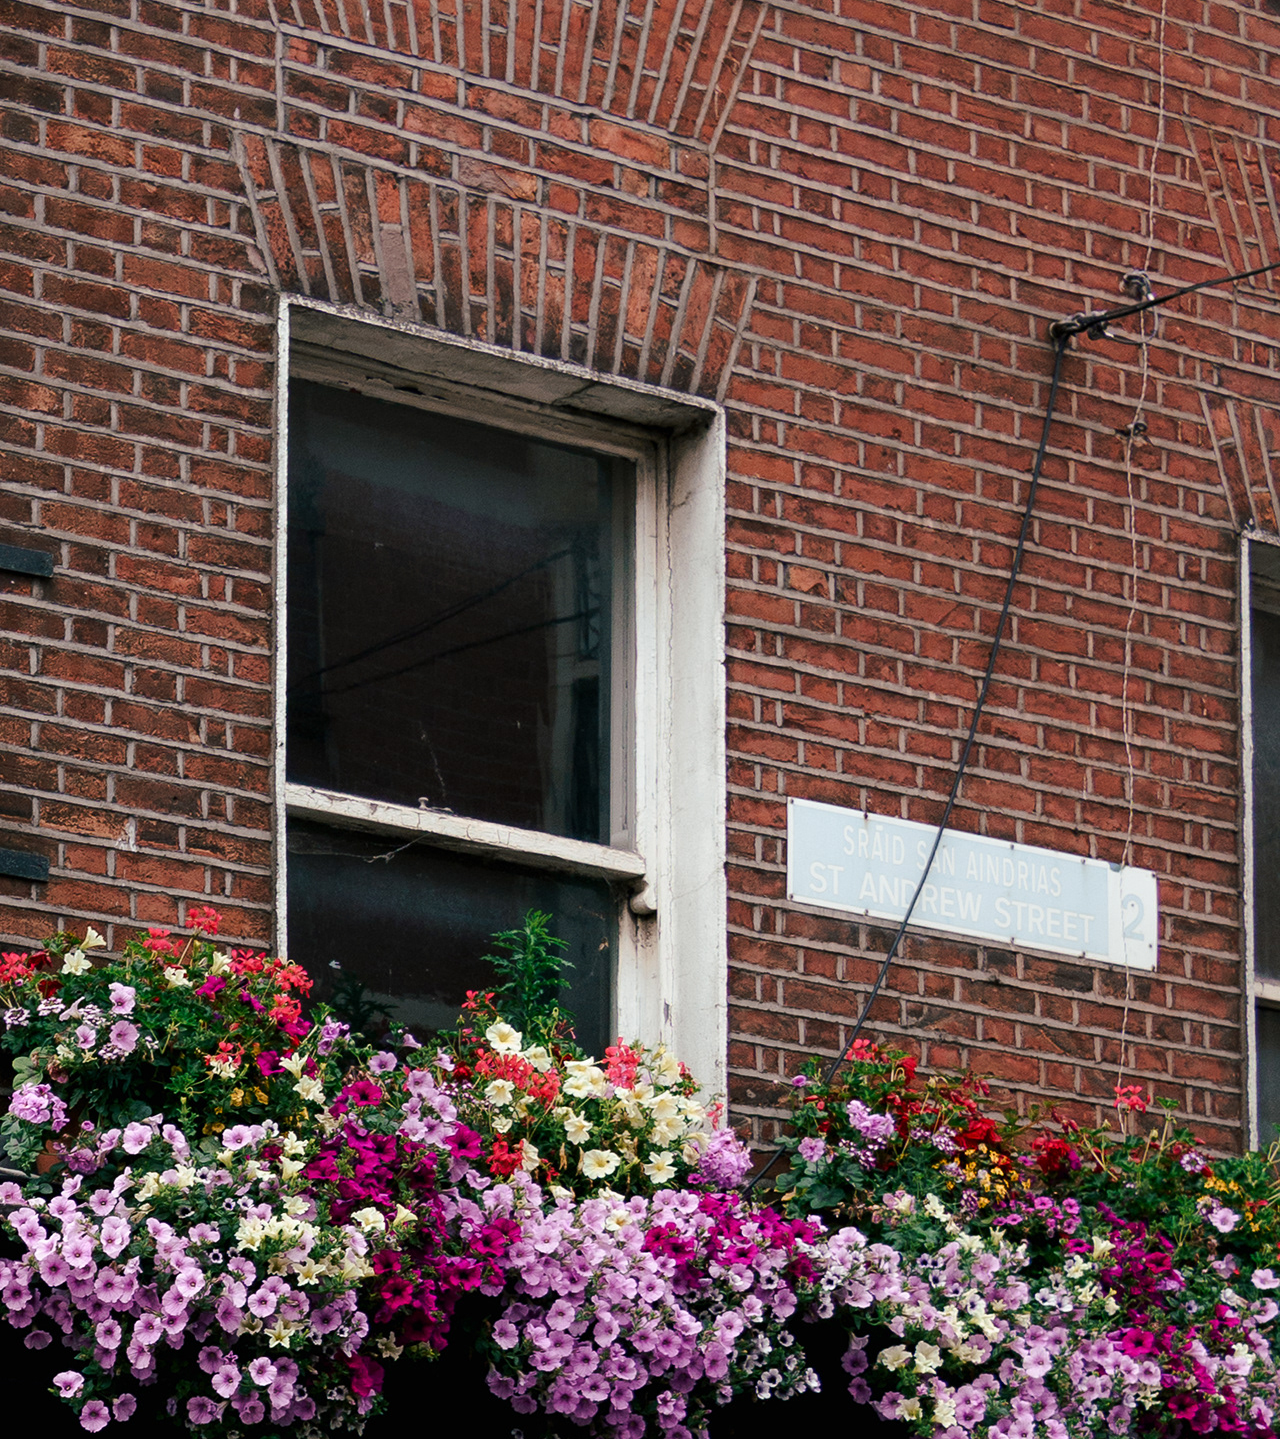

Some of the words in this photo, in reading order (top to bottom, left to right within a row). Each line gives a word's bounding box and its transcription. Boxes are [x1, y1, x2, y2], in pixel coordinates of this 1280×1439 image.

[809, 861, 844, 894] ST
[858, 871, 982, 923] ANDREW
[994, 896, 1095, 943] STREET
[1121, 893, 1146, 941] 2
[966, 851, 1062, 897] AINDRIAS
